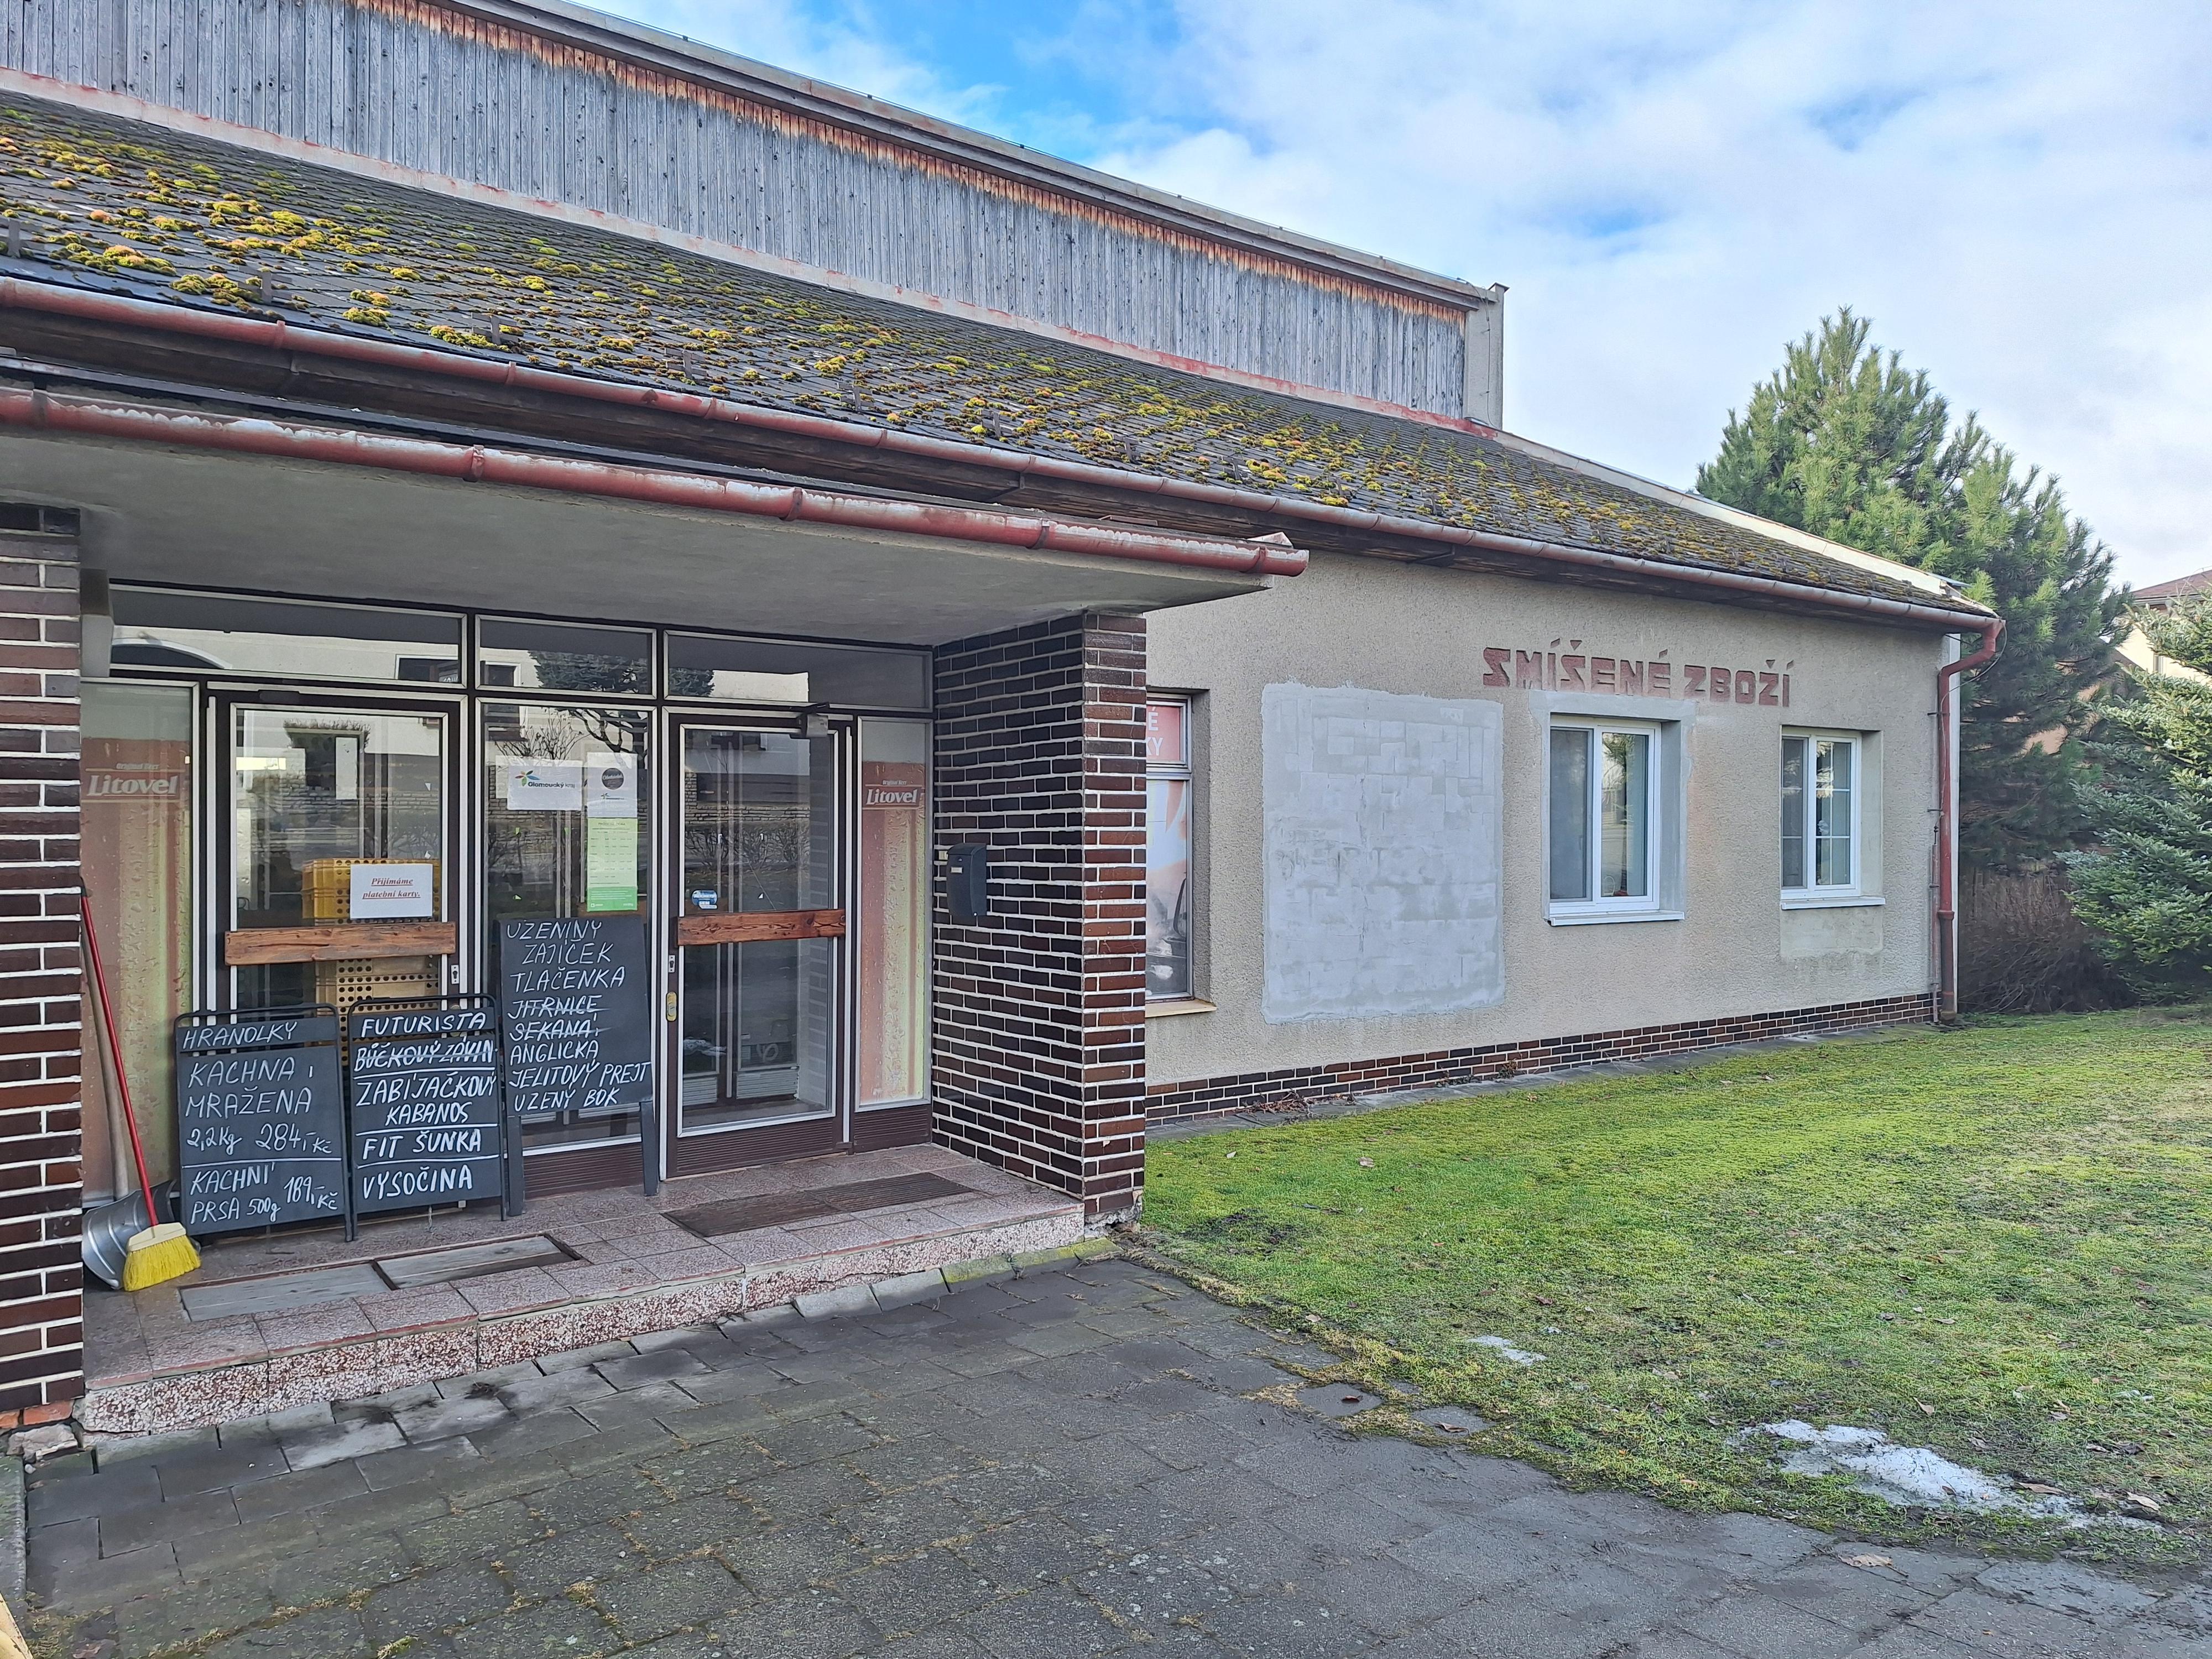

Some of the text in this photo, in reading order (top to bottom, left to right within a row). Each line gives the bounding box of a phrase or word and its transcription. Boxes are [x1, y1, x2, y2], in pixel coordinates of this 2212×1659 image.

[1483, 638, 1795, 707] SMÍŠENÉ ZBOŽÍ
[86, 774, 179, 796] Litovel
[866, 788, 918, 805] Litovel
[371, 878, 414, 886] Přijímáme
[507, 920, 602, 940] UZENINY
[510, 966, 625, 993] TLAČENKA
[508, 995, 602, 1019] JITRNICE
[182, 1021, 298, 1050] HRANOLKY
[361, 1012, 487, 1038] FUTURISTA
[188, 1057, 295, 1088] KACHNA
[509, 1060, 651, 1089] JELITOVÝ PREJT
[356, 1071, 497, 1106] ZABÍJAČKOVÝ
[583, 1087, 620, 1107] BOK
[385, 1102, 473, 1126] KABANOS
[363, 1129, 482, 1160] FIT ŠUNKA
[190, 1162, 276, 1196] KACHNÍ
[363, 1165, 473, 1200] VYSOČINA
[190, 1197, 281, 1224] PRSA 500g
